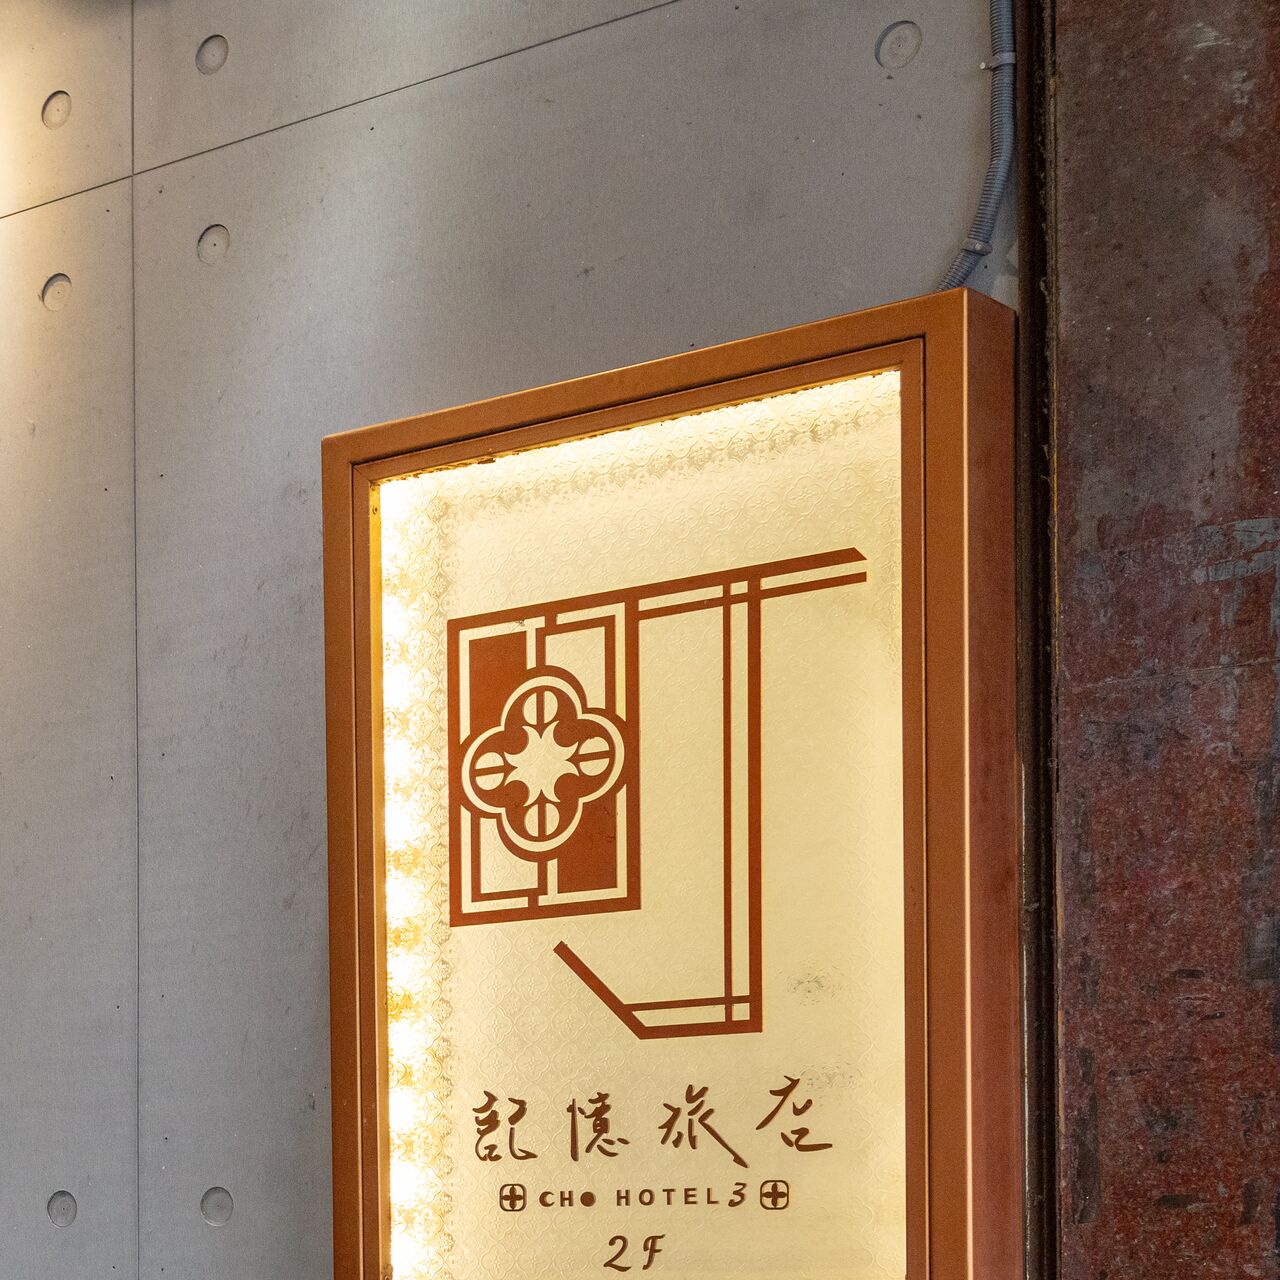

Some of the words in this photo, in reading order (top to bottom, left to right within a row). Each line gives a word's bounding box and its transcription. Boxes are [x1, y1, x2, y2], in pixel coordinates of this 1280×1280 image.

[472, 1075, 833, 1169] 記憶旅店
[603, 1234, 666, 1272] 2F
